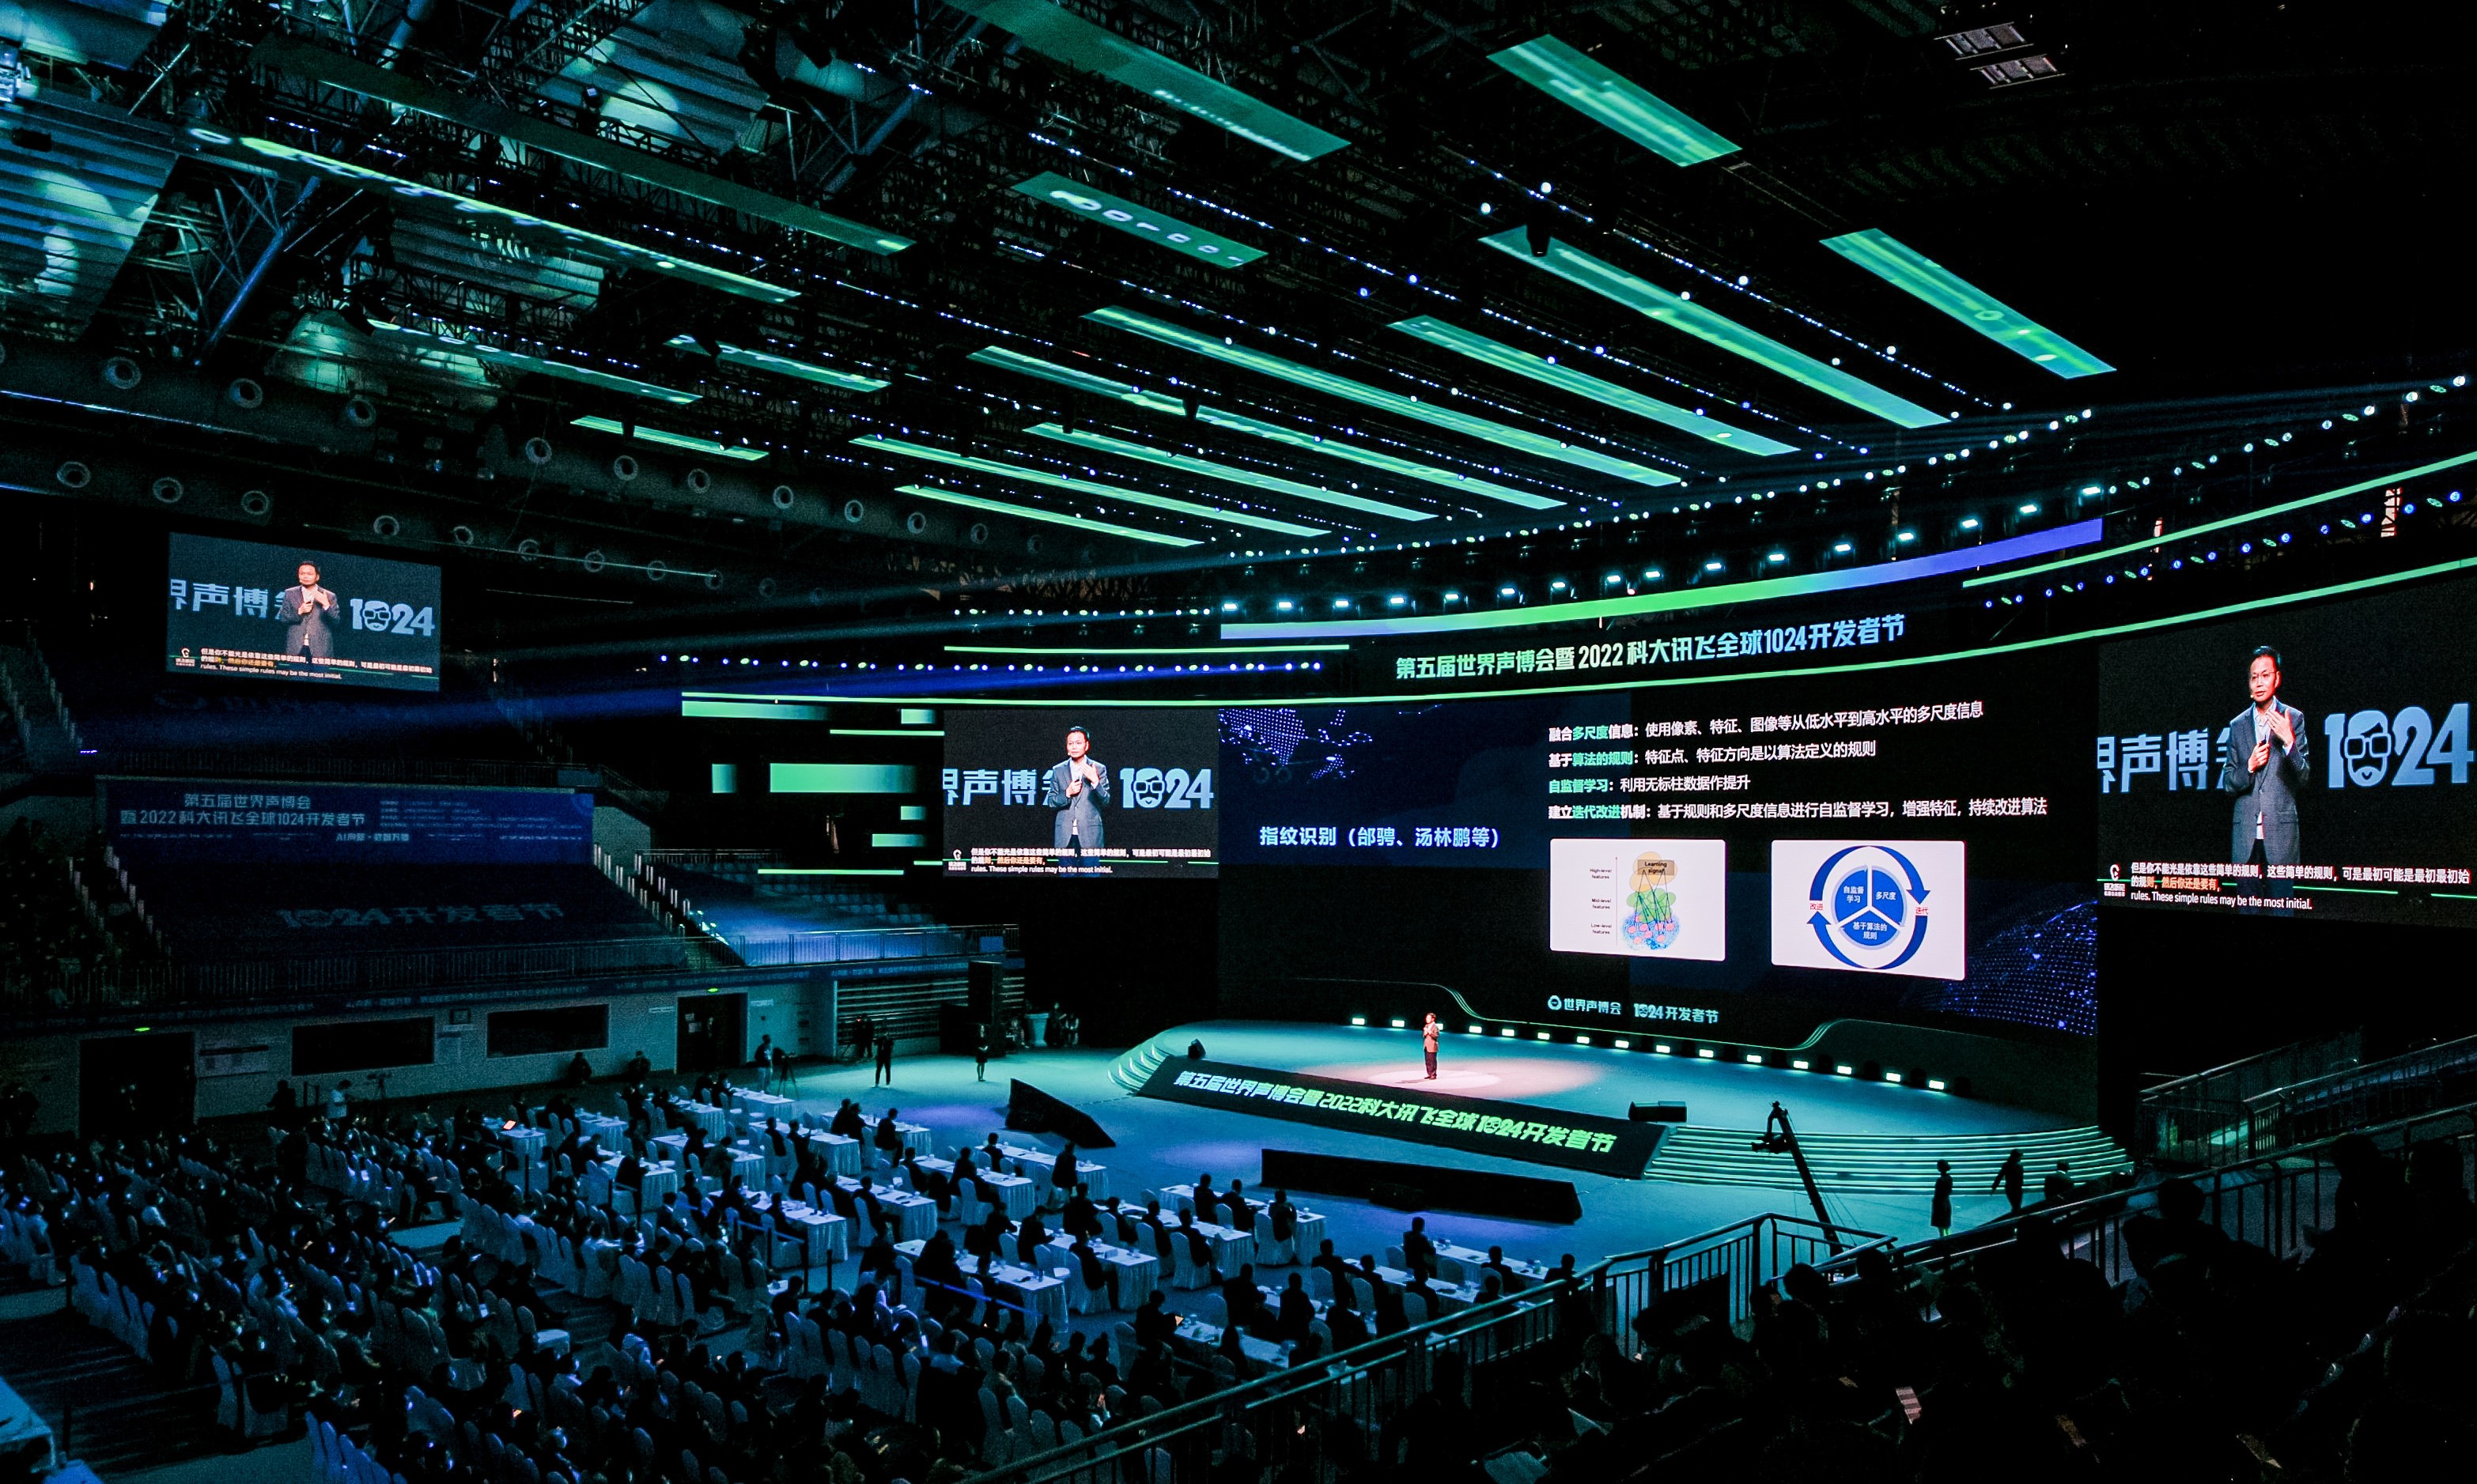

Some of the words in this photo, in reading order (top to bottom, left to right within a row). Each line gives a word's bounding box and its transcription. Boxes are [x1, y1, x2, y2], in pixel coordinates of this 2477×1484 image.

[184, 793, 312, 809] 第五届世界声博会
[1876, 892, 1896, 901] 多尺度
[2152, 892, 2173, 902] These
[2175, 894, 2199, 904] simple
[2200, 895, 2218, 904] rules
[2220, 897, 2236, 907] may
[2237, 896, 2247, 905] be
[2249, 896, 2262, 906] the
[2263, 898, 2284, 908] most
[2286, 897, 2312, 909] initial.
[1853, 922, 1887, 931] 基于算法的
[1564, 999, 1621, 1015] 世界声博会
